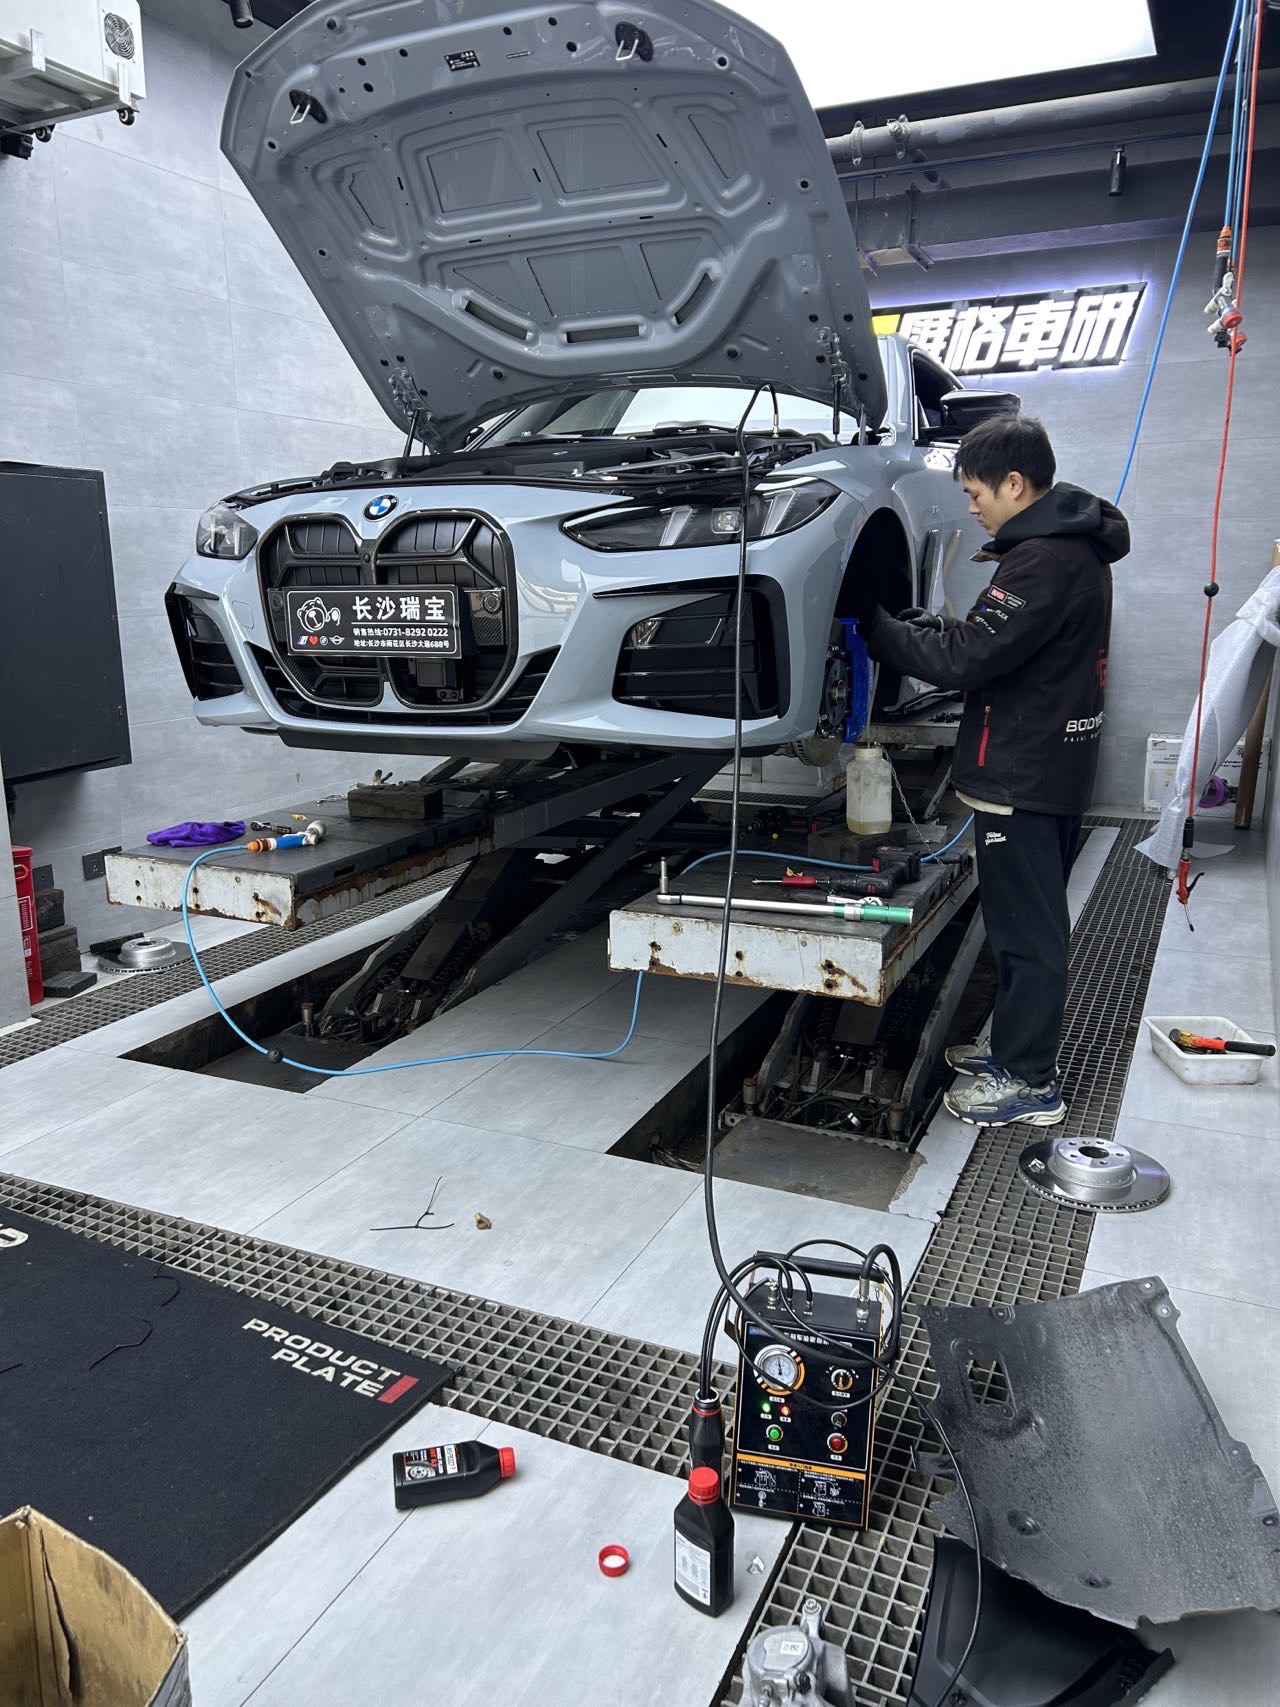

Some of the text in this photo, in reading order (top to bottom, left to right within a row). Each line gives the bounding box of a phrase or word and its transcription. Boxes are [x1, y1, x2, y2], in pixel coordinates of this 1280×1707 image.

[352, 596, 446, 621] 长沙瑞宝
[427, 628, 449, 637] 0222
[242, 1318, 401, 1381] PRODUCT
[271, 1348, 385, 1398] PLATE
